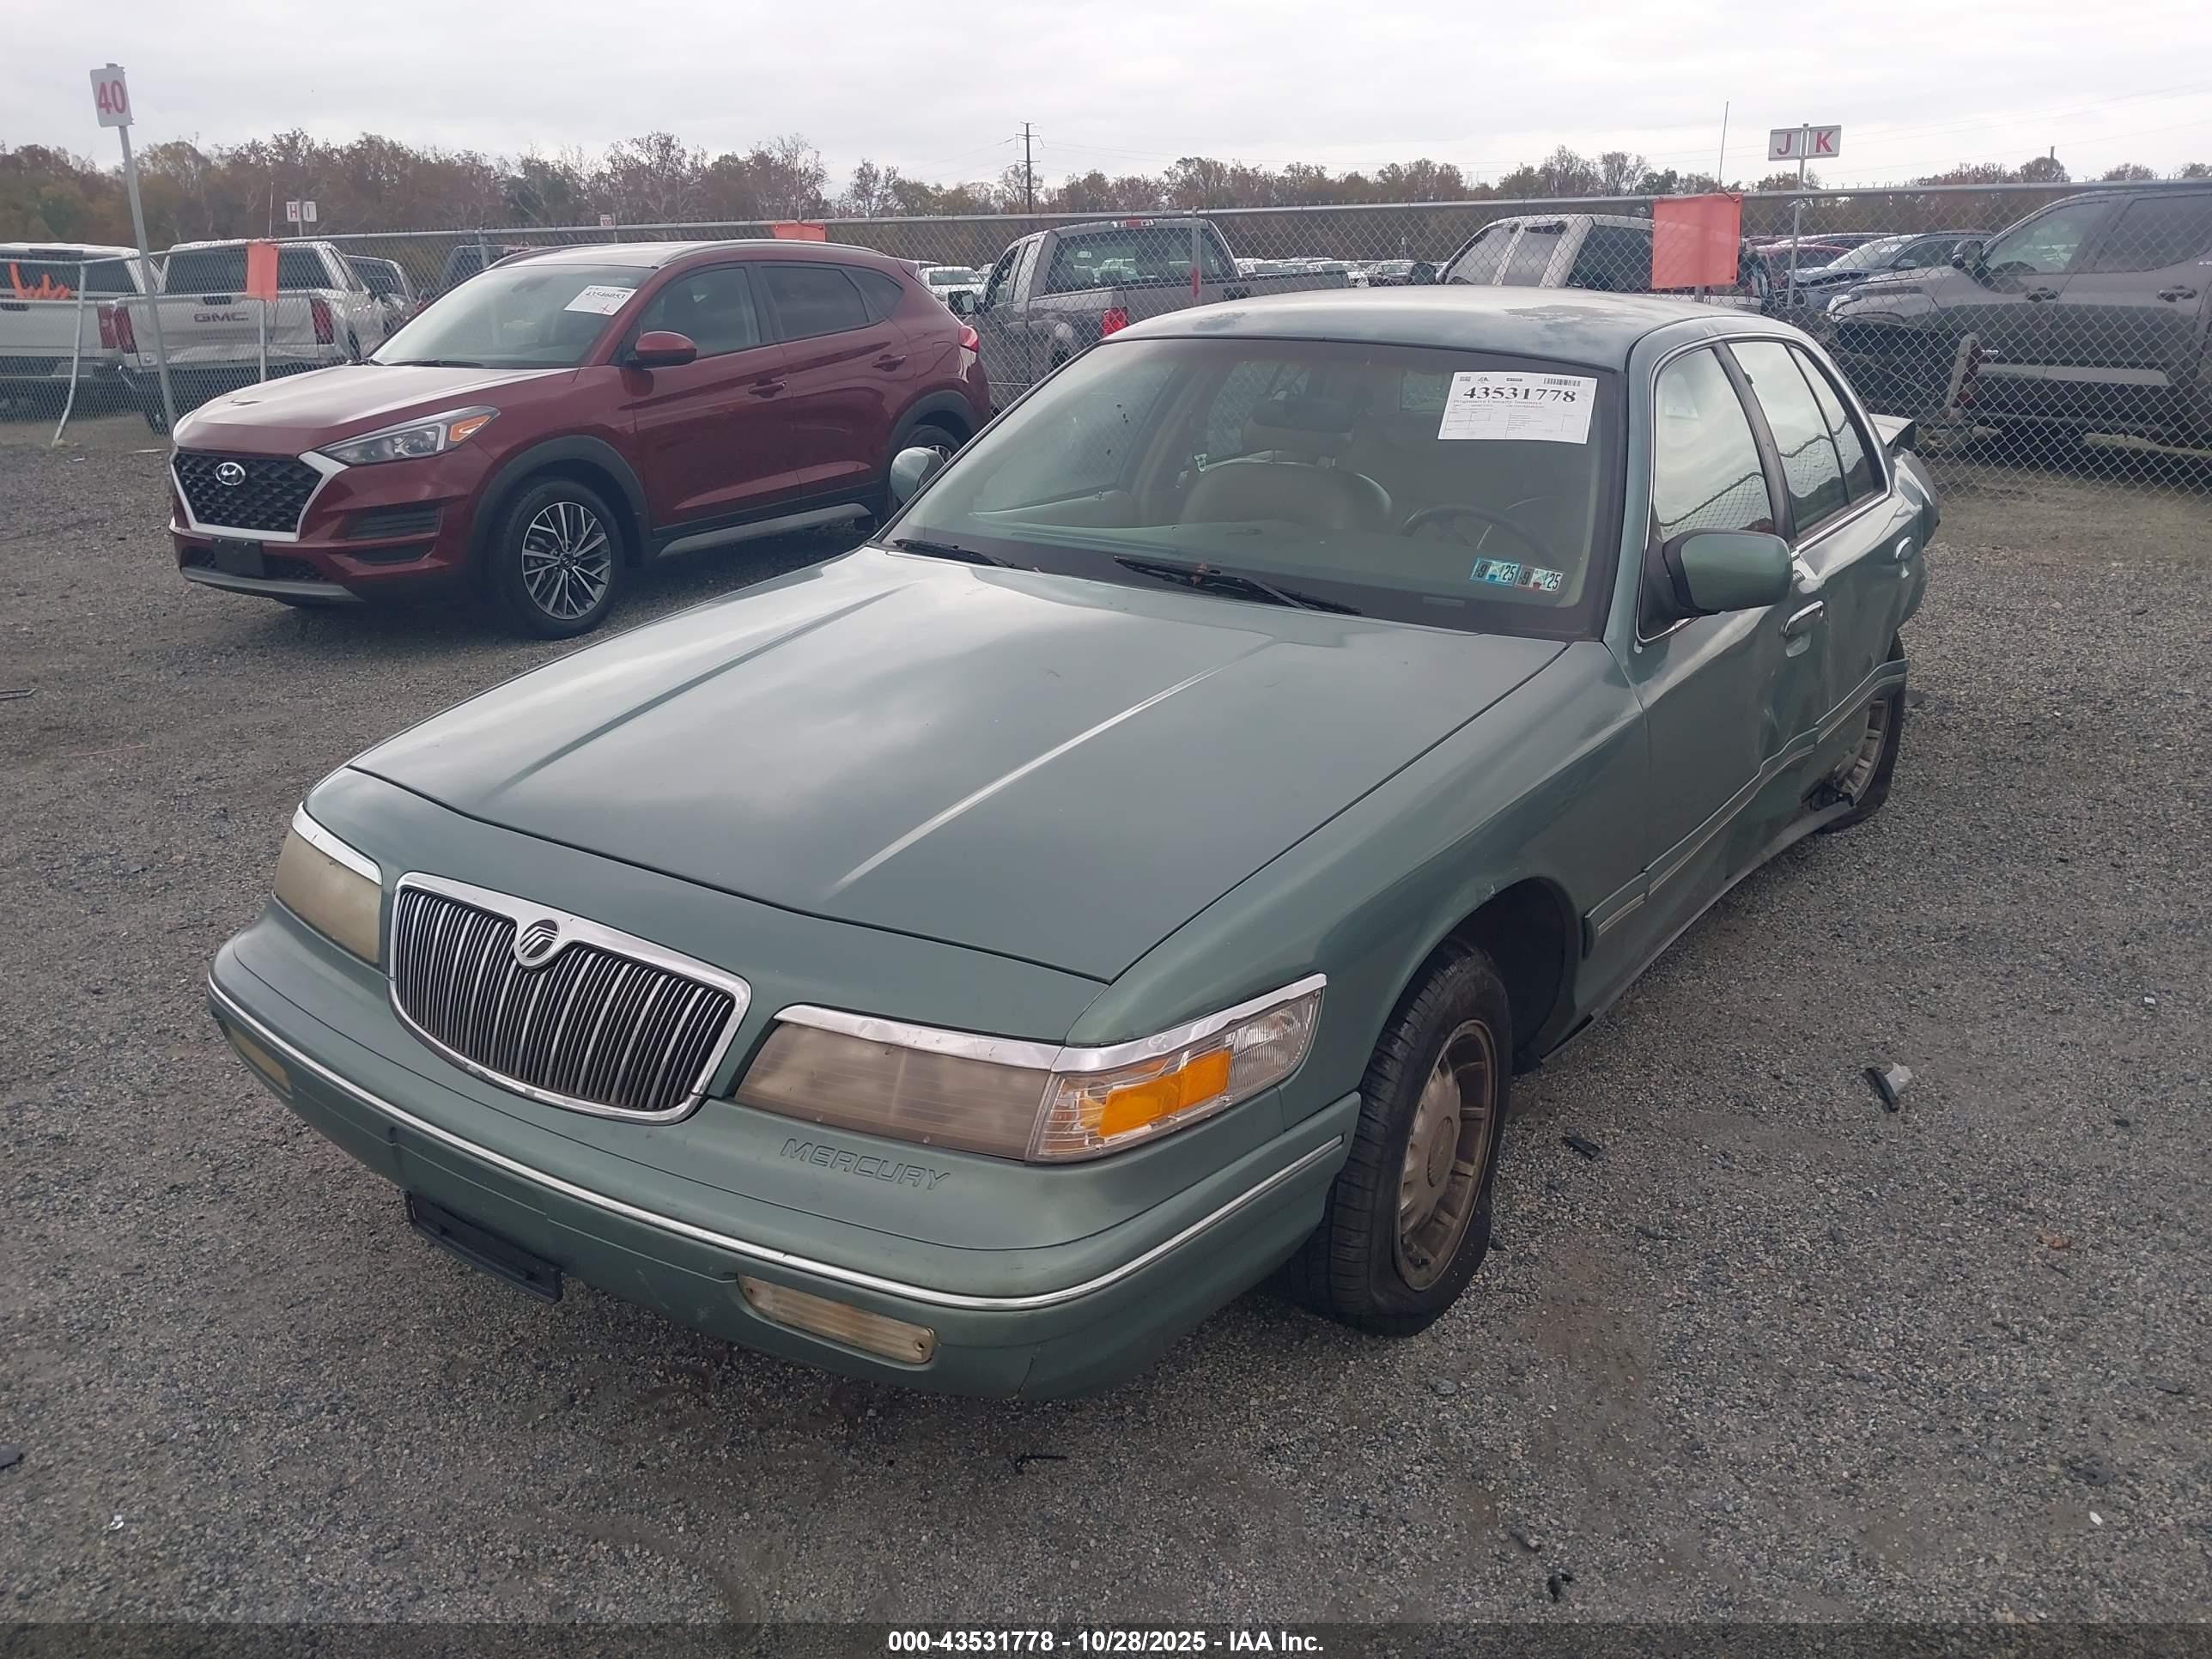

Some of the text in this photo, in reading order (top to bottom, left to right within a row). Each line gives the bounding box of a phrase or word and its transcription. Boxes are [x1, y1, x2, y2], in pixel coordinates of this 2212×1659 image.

[98, 80, 126, 114] 40
[1776, 131, 1834, 155] J K
[289, 205, 298, 219] H
[194, 312, 249, 322] GMC
[1462, 386, 1577, 402] 43531778
[1503, 565, 1517, 581] 25
[1547, 573, 1561, 590] 25
[780, 1138, 951, 1190] MERCURY
